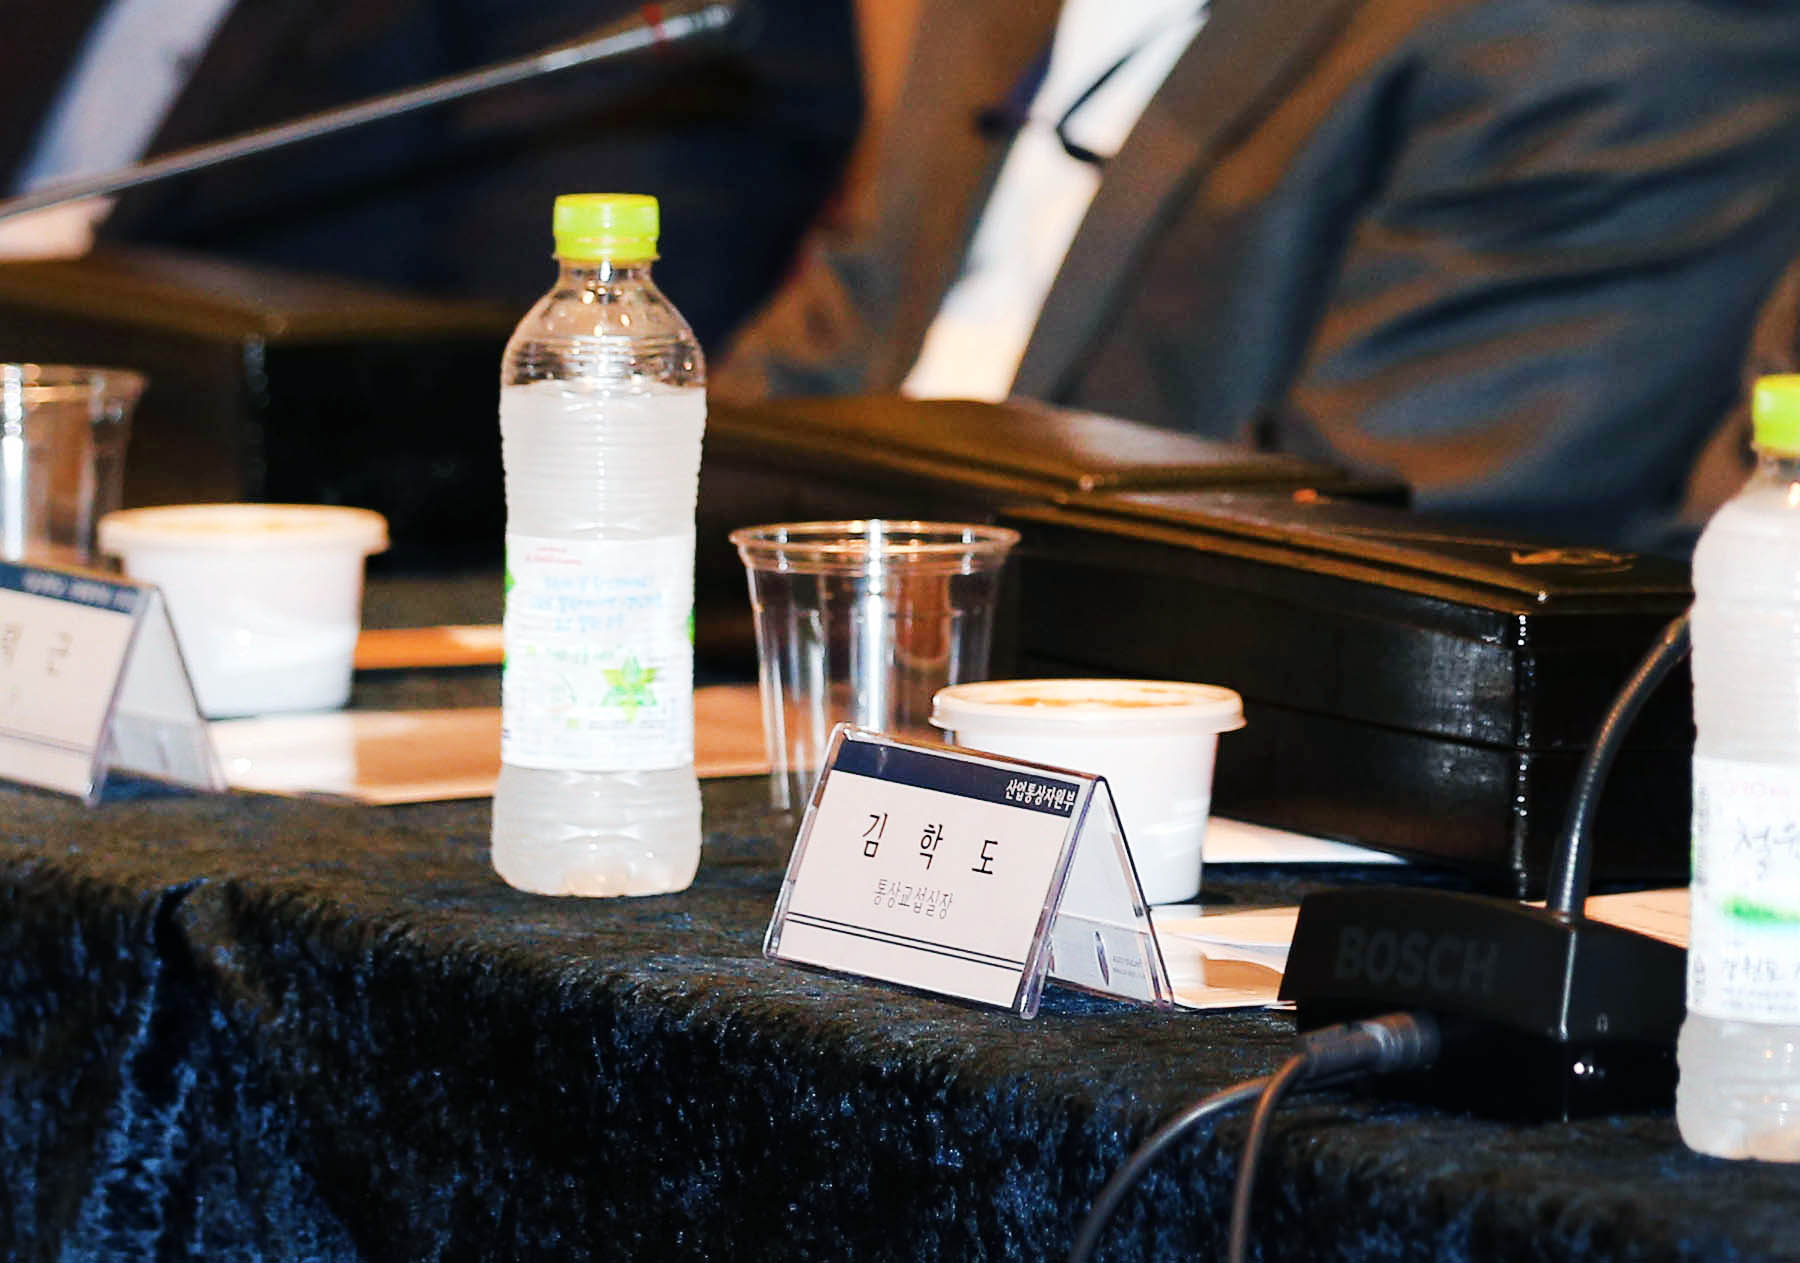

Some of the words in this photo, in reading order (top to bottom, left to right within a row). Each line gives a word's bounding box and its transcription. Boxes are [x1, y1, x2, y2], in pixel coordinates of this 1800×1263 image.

[1005, 778, 1077, 813] 산업통상자원부
[873, 878, 954, 921] 통상교섭실장
[1333, 924, 1502, 998] BOSCH
